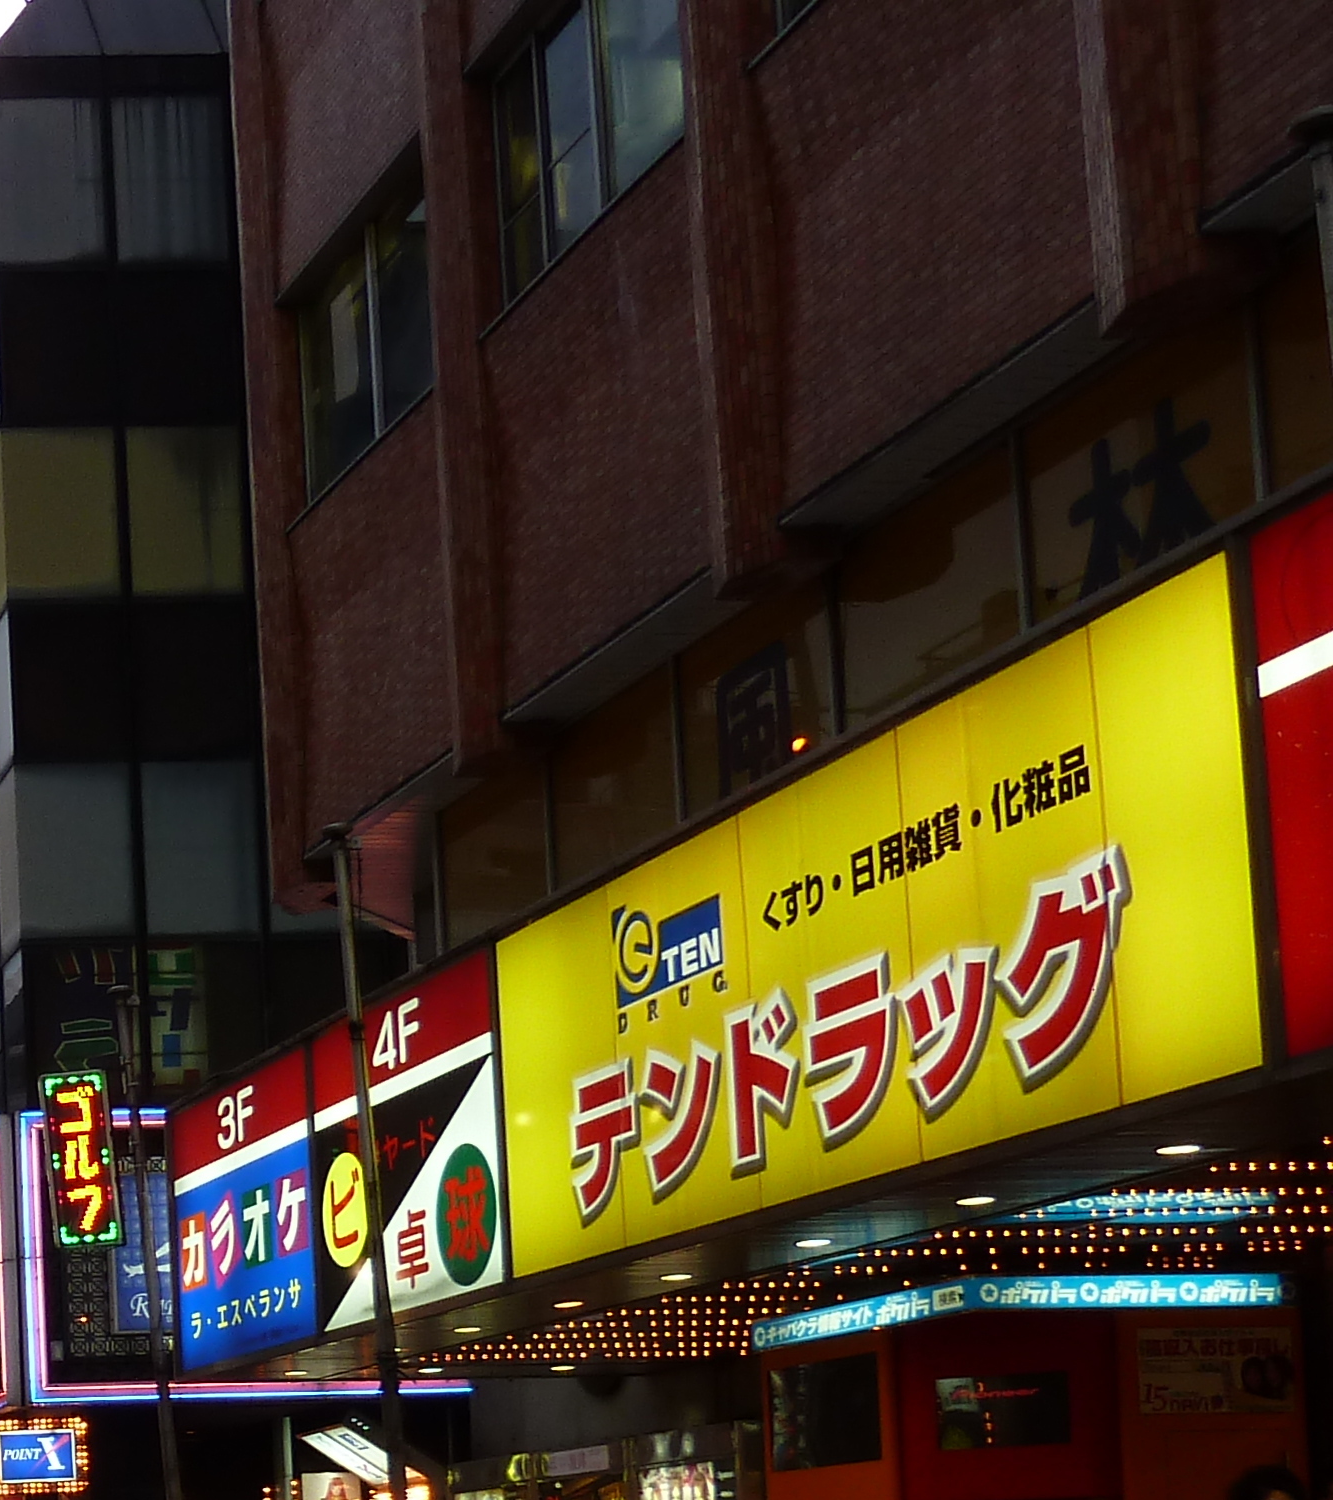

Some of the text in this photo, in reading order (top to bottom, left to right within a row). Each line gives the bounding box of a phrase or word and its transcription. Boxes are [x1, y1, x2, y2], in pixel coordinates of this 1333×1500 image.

[661, 927, 720, 983] TEN
[371, 996, 420, 1071] 4F
[570, 842, 1133, 1229] テンドラッグ
[618, 971, 728, 1035] DRUG
[216, 1084, 255, 1151] 3F
[181, 1177, 307, 1289] カラオケ
[2, 1436, 66, 1471] POINT X
